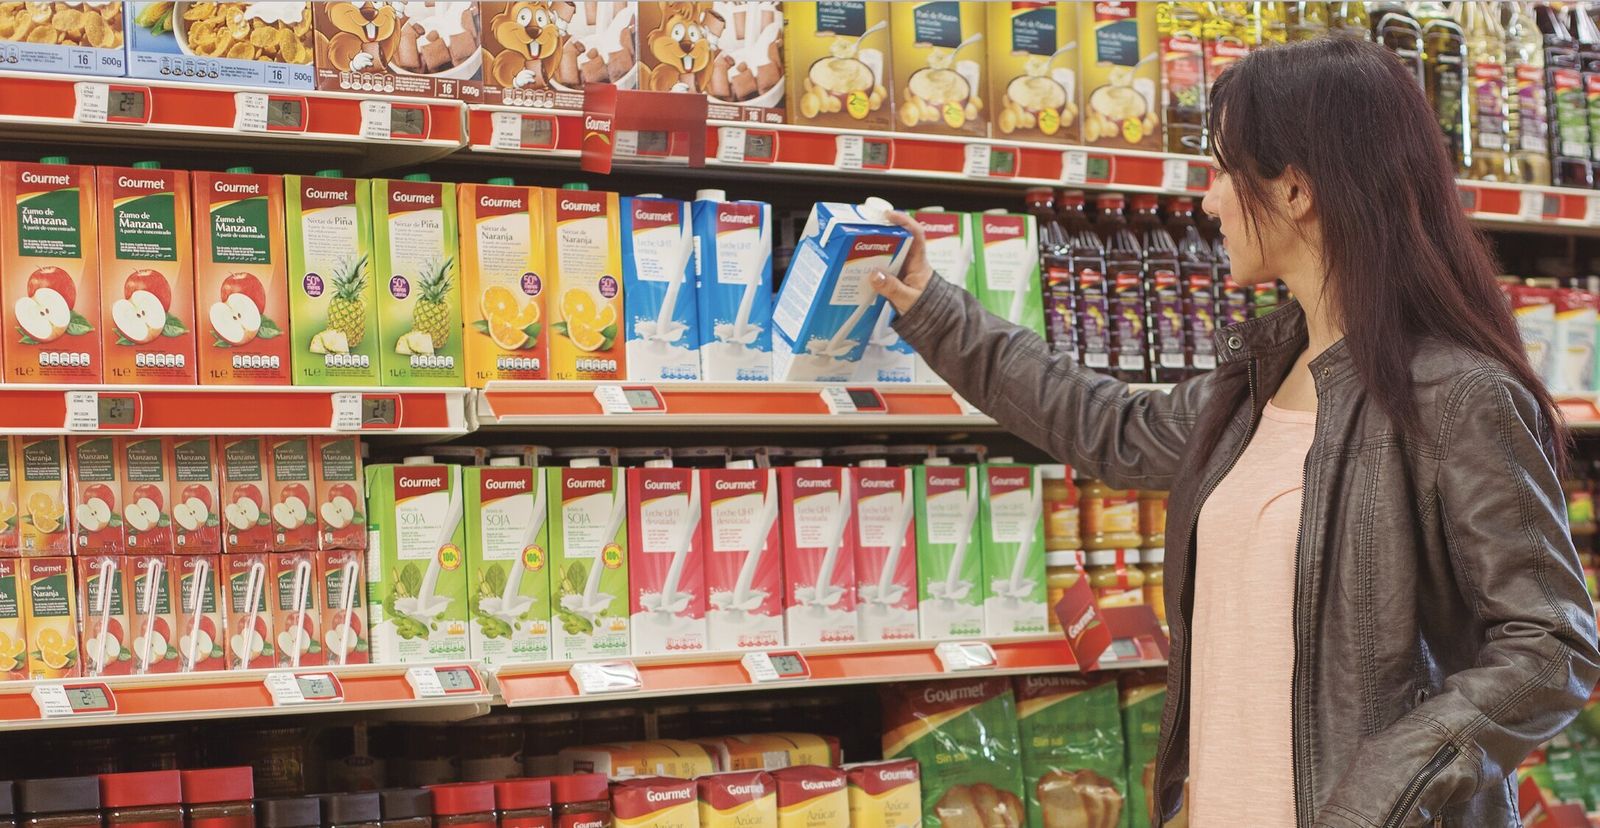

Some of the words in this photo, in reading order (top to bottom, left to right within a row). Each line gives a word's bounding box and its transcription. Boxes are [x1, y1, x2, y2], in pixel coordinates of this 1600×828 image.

[78, 54, 88, 64] 16
[102, 57, 122, 68] 500g
[272, 70, 282, 80] 16
[294, 73, 312, 82] 500g
[442, 84, 452, 94] 16
[462, 86, 479, 97] 500g
[585, 116, 611, 132] Gourmet
[22, 172, 70, 185] Gourmet
[118, 176, 164, 190] Gourmet
[215, 181, 259, 194] Gourmet
[306, 188, 348, 200] Gourmet
[393, 191, 434, 204] Gourmet
[480, 196, 521, 208] Gourmet
[561, 200, 600, 212] Gourmet
[22, 207, 43, 215] Zumo
[635, 210, 672, 221] Gourmet
[22, 214, 68, 226] Manzana
[119, 218, 163, 229] Manzana
[334, 217, 352, 226] Piña
[720, 212, 754, 224] Gourmet
[216, 223, 257, 232] Manzana
[421, 220, 439, 229] Piña
[985, 224, 1019, 235] Gourmet
[482, 232, 513, 241] Naranja
[562, 235, 592, 245] Naranja
[855, 242, 891, 251] Gourmet
[400, 477, 441, 488] Gourmet
[486, 478, 525, 490] Gourmet
[567, 478, 606, 488] Gourmet
[645, 480, 681, 490] Gourmet
[716, 480, 756, 490] Gourmet
[797, 478, 831, 488] Gourmet
[861, 478, 895, 488] Gourmet
[929, 476, 960, 486] Gourmet
[992, 476, 1024, 486] Gourmet
[401, 513, 425, 524] SOJA
[487, 514, 510, 525] SOJA
[568, 513, 590, 524] SOJA
[1068, 606, 1095, 639] Gourmet
[483, 656, 492, 664] 1L
[924, 685, 984, 703] Gourmet
[936, 754, 951, 764] Sin
[727, 784, 764, 795] Gourmet
[802, 778, 842, 790] Gourmet
[647, 788, 690, 802] Gourmet
